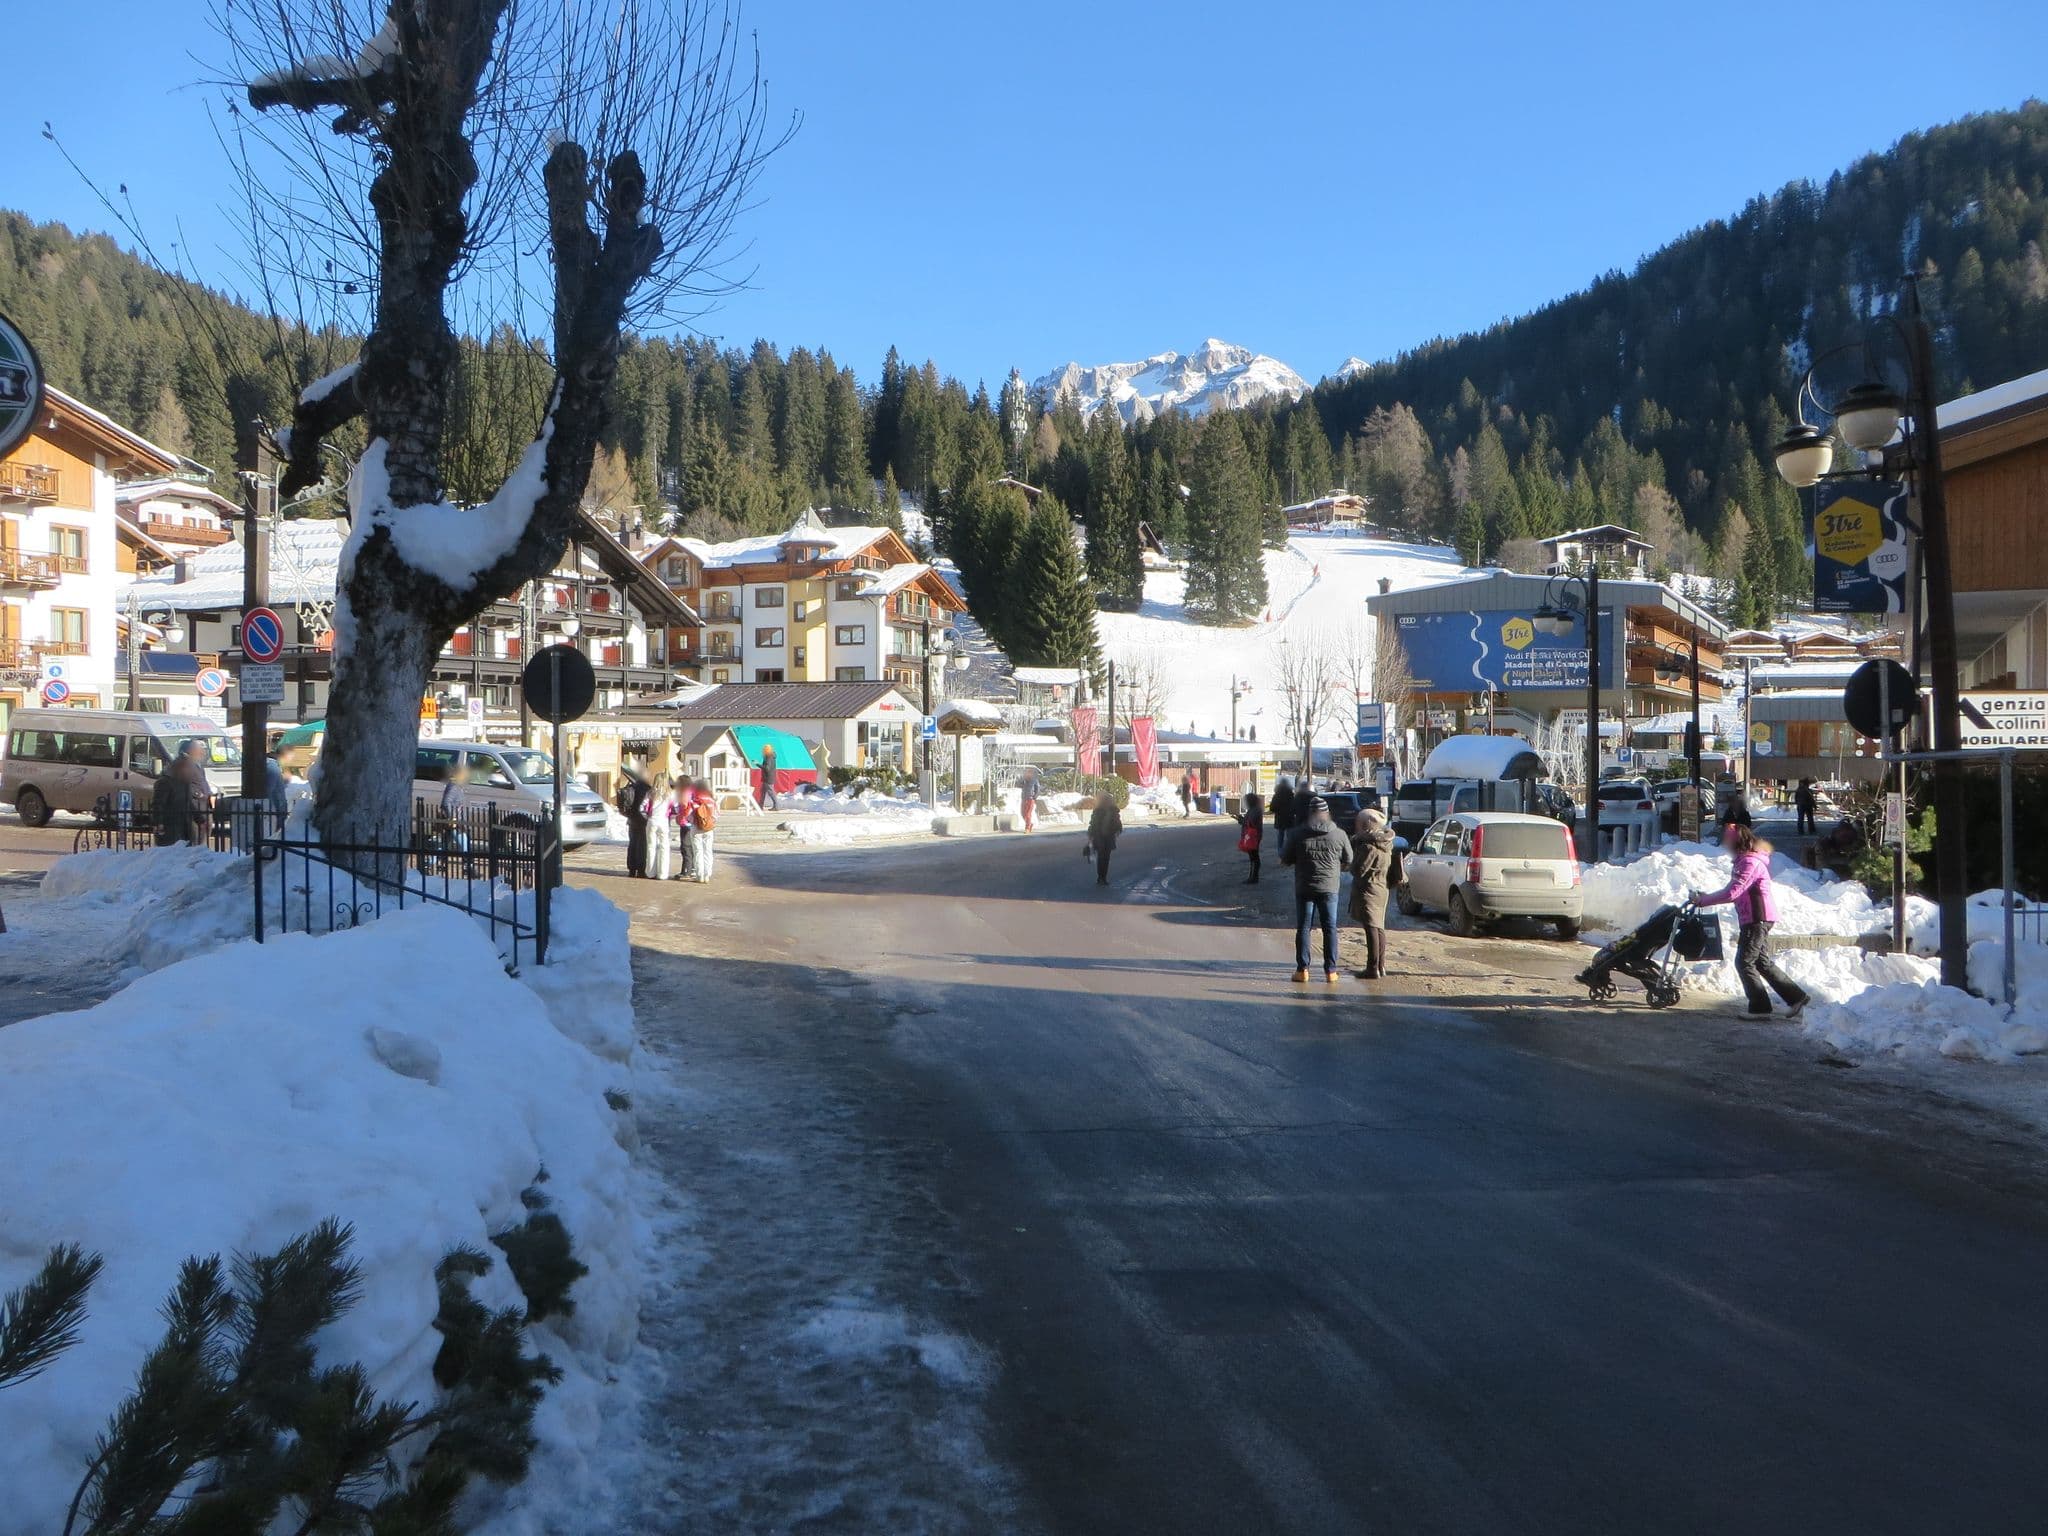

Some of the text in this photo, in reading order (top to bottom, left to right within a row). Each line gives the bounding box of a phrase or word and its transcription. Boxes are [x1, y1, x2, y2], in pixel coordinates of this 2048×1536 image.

[1981, 698, 2046, 714] genzia
[924, 717, 935, 731] P
[1996, 716, 2046, 730] collini
[1620, 749, 1630, 761] P
